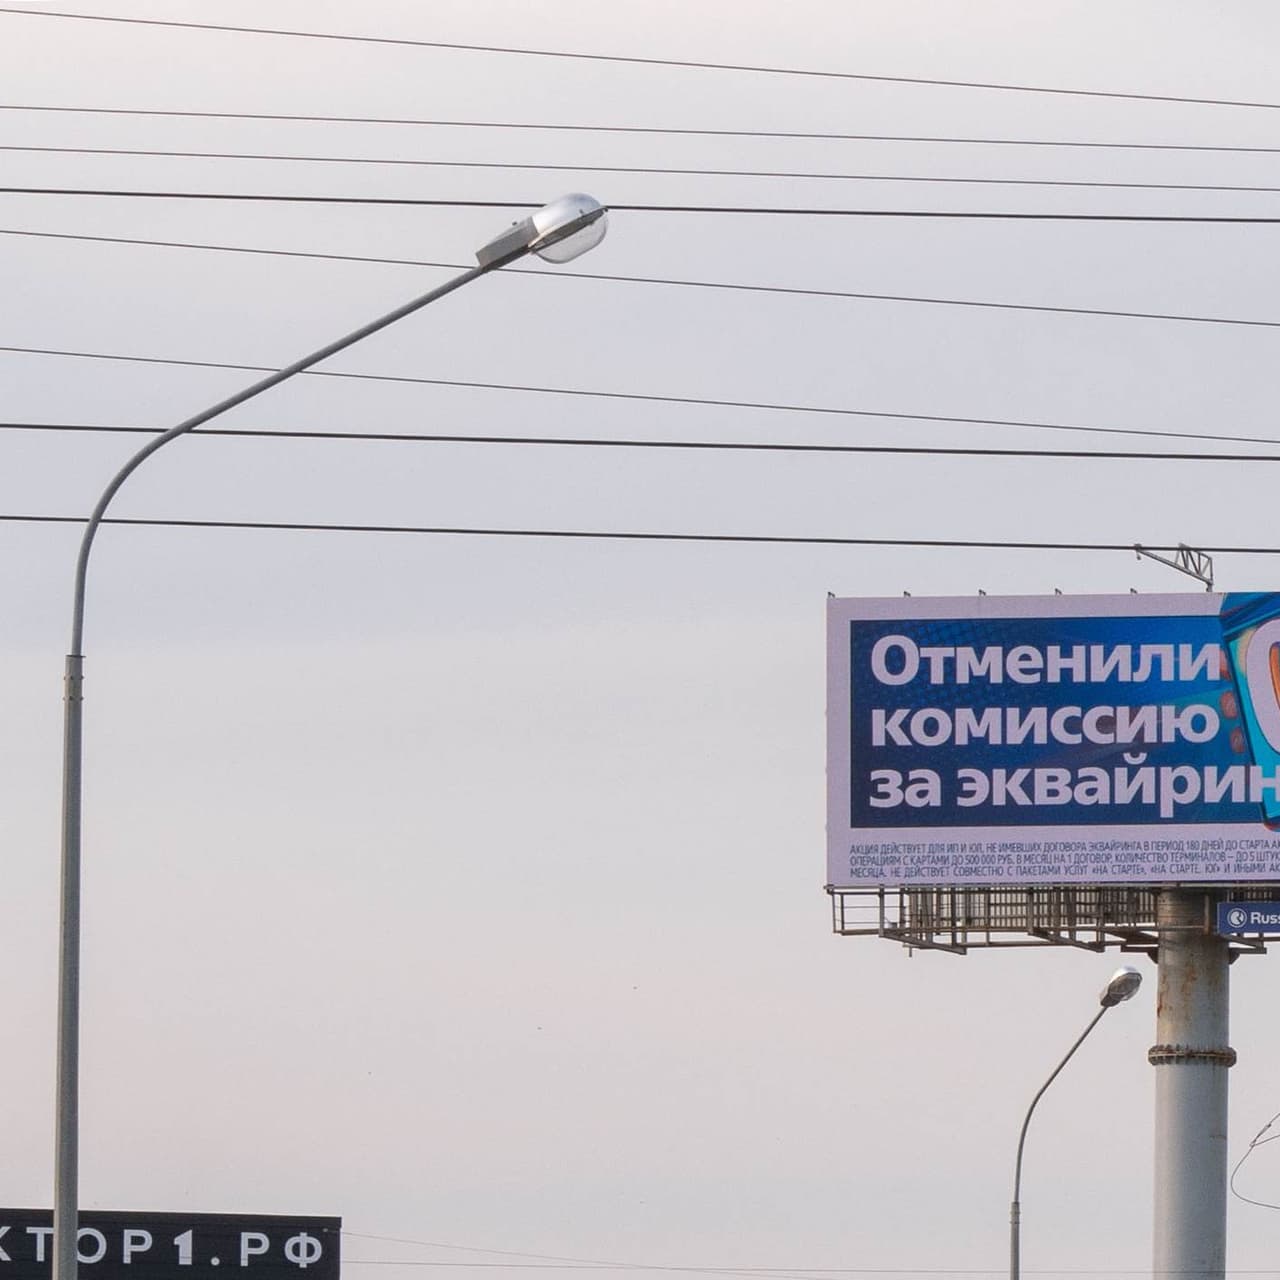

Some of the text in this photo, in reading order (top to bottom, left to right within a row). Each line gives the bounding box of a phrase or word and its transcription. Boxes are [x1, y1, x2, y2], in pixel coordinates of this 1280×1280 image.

[871, 635, 1220, 686] Отменили
[872, 703, 1220, 746] комиссию
[869, 768, 942, 808] за
[850, 843, 878, 854] АКЦИЯ
[880, 842, 926, 854] ДЕЙСТВУЕТ
[928, 843, 945, 853] ДЛЯ
[960, 842, 966, 853] И
[985, 842, 998, 853] НЕ
[998, 842, 1041, 852] ИМЕВШИХ
[1042, 841, 1086, 852] ДОГОВОРА
[1088, 839, 1142, 851] ЭКВАЙРИНГА
[1143, 840, 1149, 851] В
[1150, 840, 1184, 851] ПЕРИОД
[1186, 840, 1199, 850] 180
[1200, 838, 1223, 850] ДНЕЙ
[1224, 839, 1237, 850] ДО
[1238, 839, 1270, 850] СТАРТА
[850, 855, 901, 866] ОПЕРАЦИЯМ
[902, 855, 908, 865] С
[910, 854, 950, 865] КАРТАМИ
[950, 854, 964, 865] ДО
[964, 854, 979, 864] 500
[981, 854, 996, 864] 000
[1016, 854, 1022, 864] В
[1024, 853, 1052, 864] МЕСЯЦ
[1053, 853, 1065, 863] НА
[1066, 853, 1071, 863] 1
[1114, 852, 1168, 863] КОЛИЧЕСТВО
[1170, 851, 1226, 862] ТЕРМИНАЛОВ
[1235, 851, 1248, 861] ДО
[1248, 851, 1254, 861] 5
[890, 867, 901, 877] НЕ
[903, 865, 949, 877] ДЕЙСТВУЕТ
[952, 866, 1004, 876] СОВМЕСТНО
[1006, 866, 1012, 876] С
[1015, 865, 1060, 876] ПАКЕТАМИ
[1062, 865, 1088, 875] УСЛУГ
[1091, 865, 1108, 875] «НА
[1223, 863, 1230, 873] И
[1232, 863, 1265, 873] ИНЫМИ
